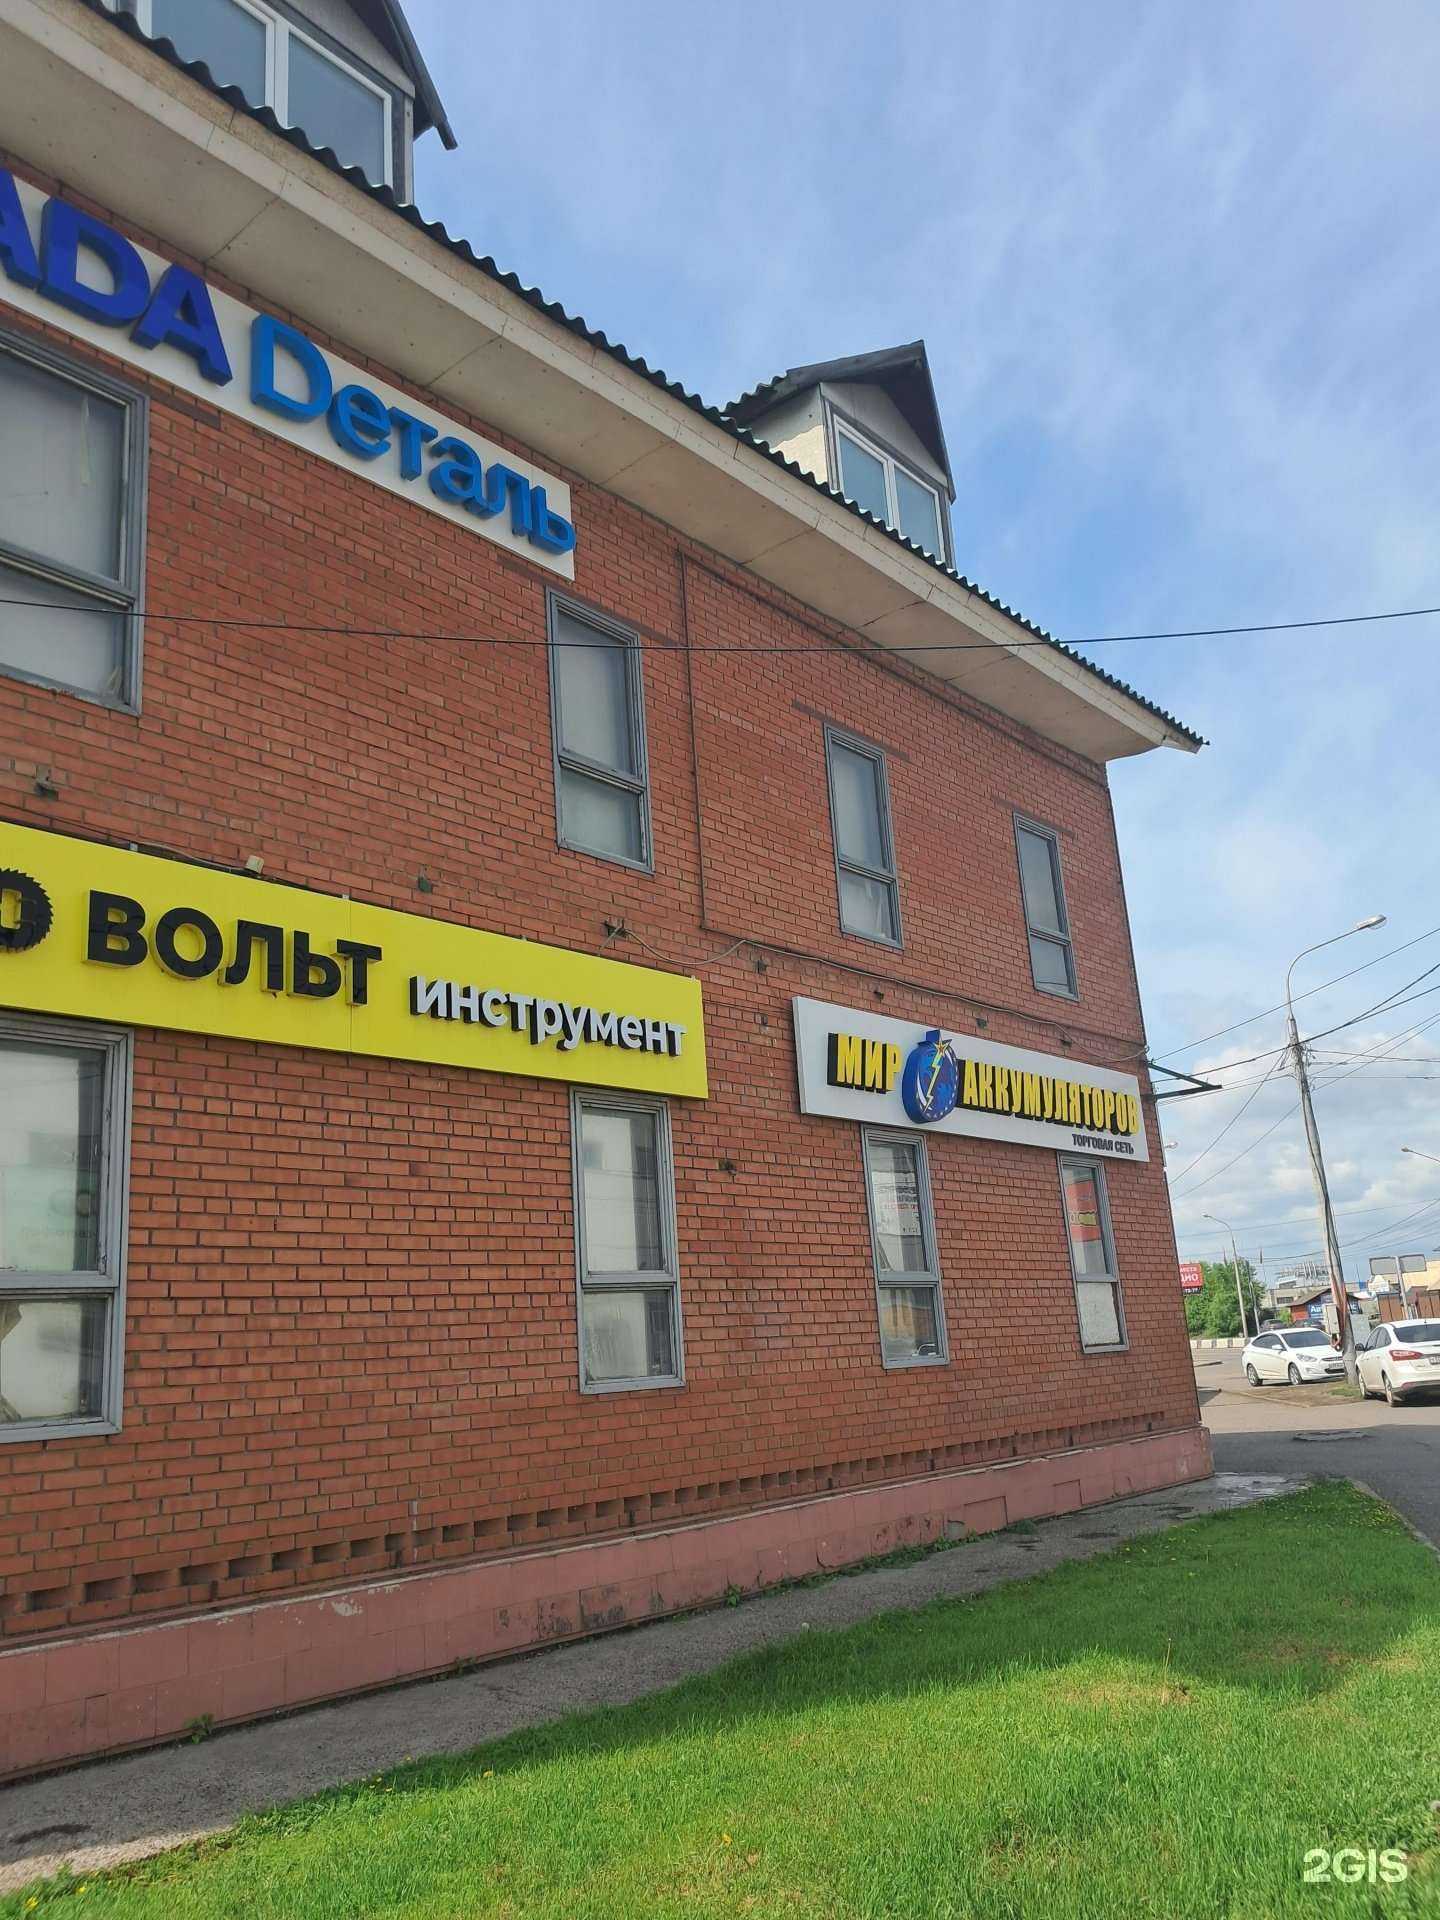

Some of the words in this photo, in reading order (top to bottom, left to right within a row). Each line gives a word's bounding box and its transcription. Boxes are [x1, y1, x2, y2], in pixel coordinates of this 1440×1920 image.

[250, 313, 576, 555] Dеталь
[83, 889, 382, 1006] ВОЛЬТ
[409, 975, 687, 1056] инструмент
[827, 1032, 900, 1094] МИР
[957, 1058, 1140, 1136] АККУМУЛЯТОРОВ
[1072, 1133, 1114, 1151] ТОРГОВАЯ
[1114, 1141, 1135, 1155] СЕТЬ
